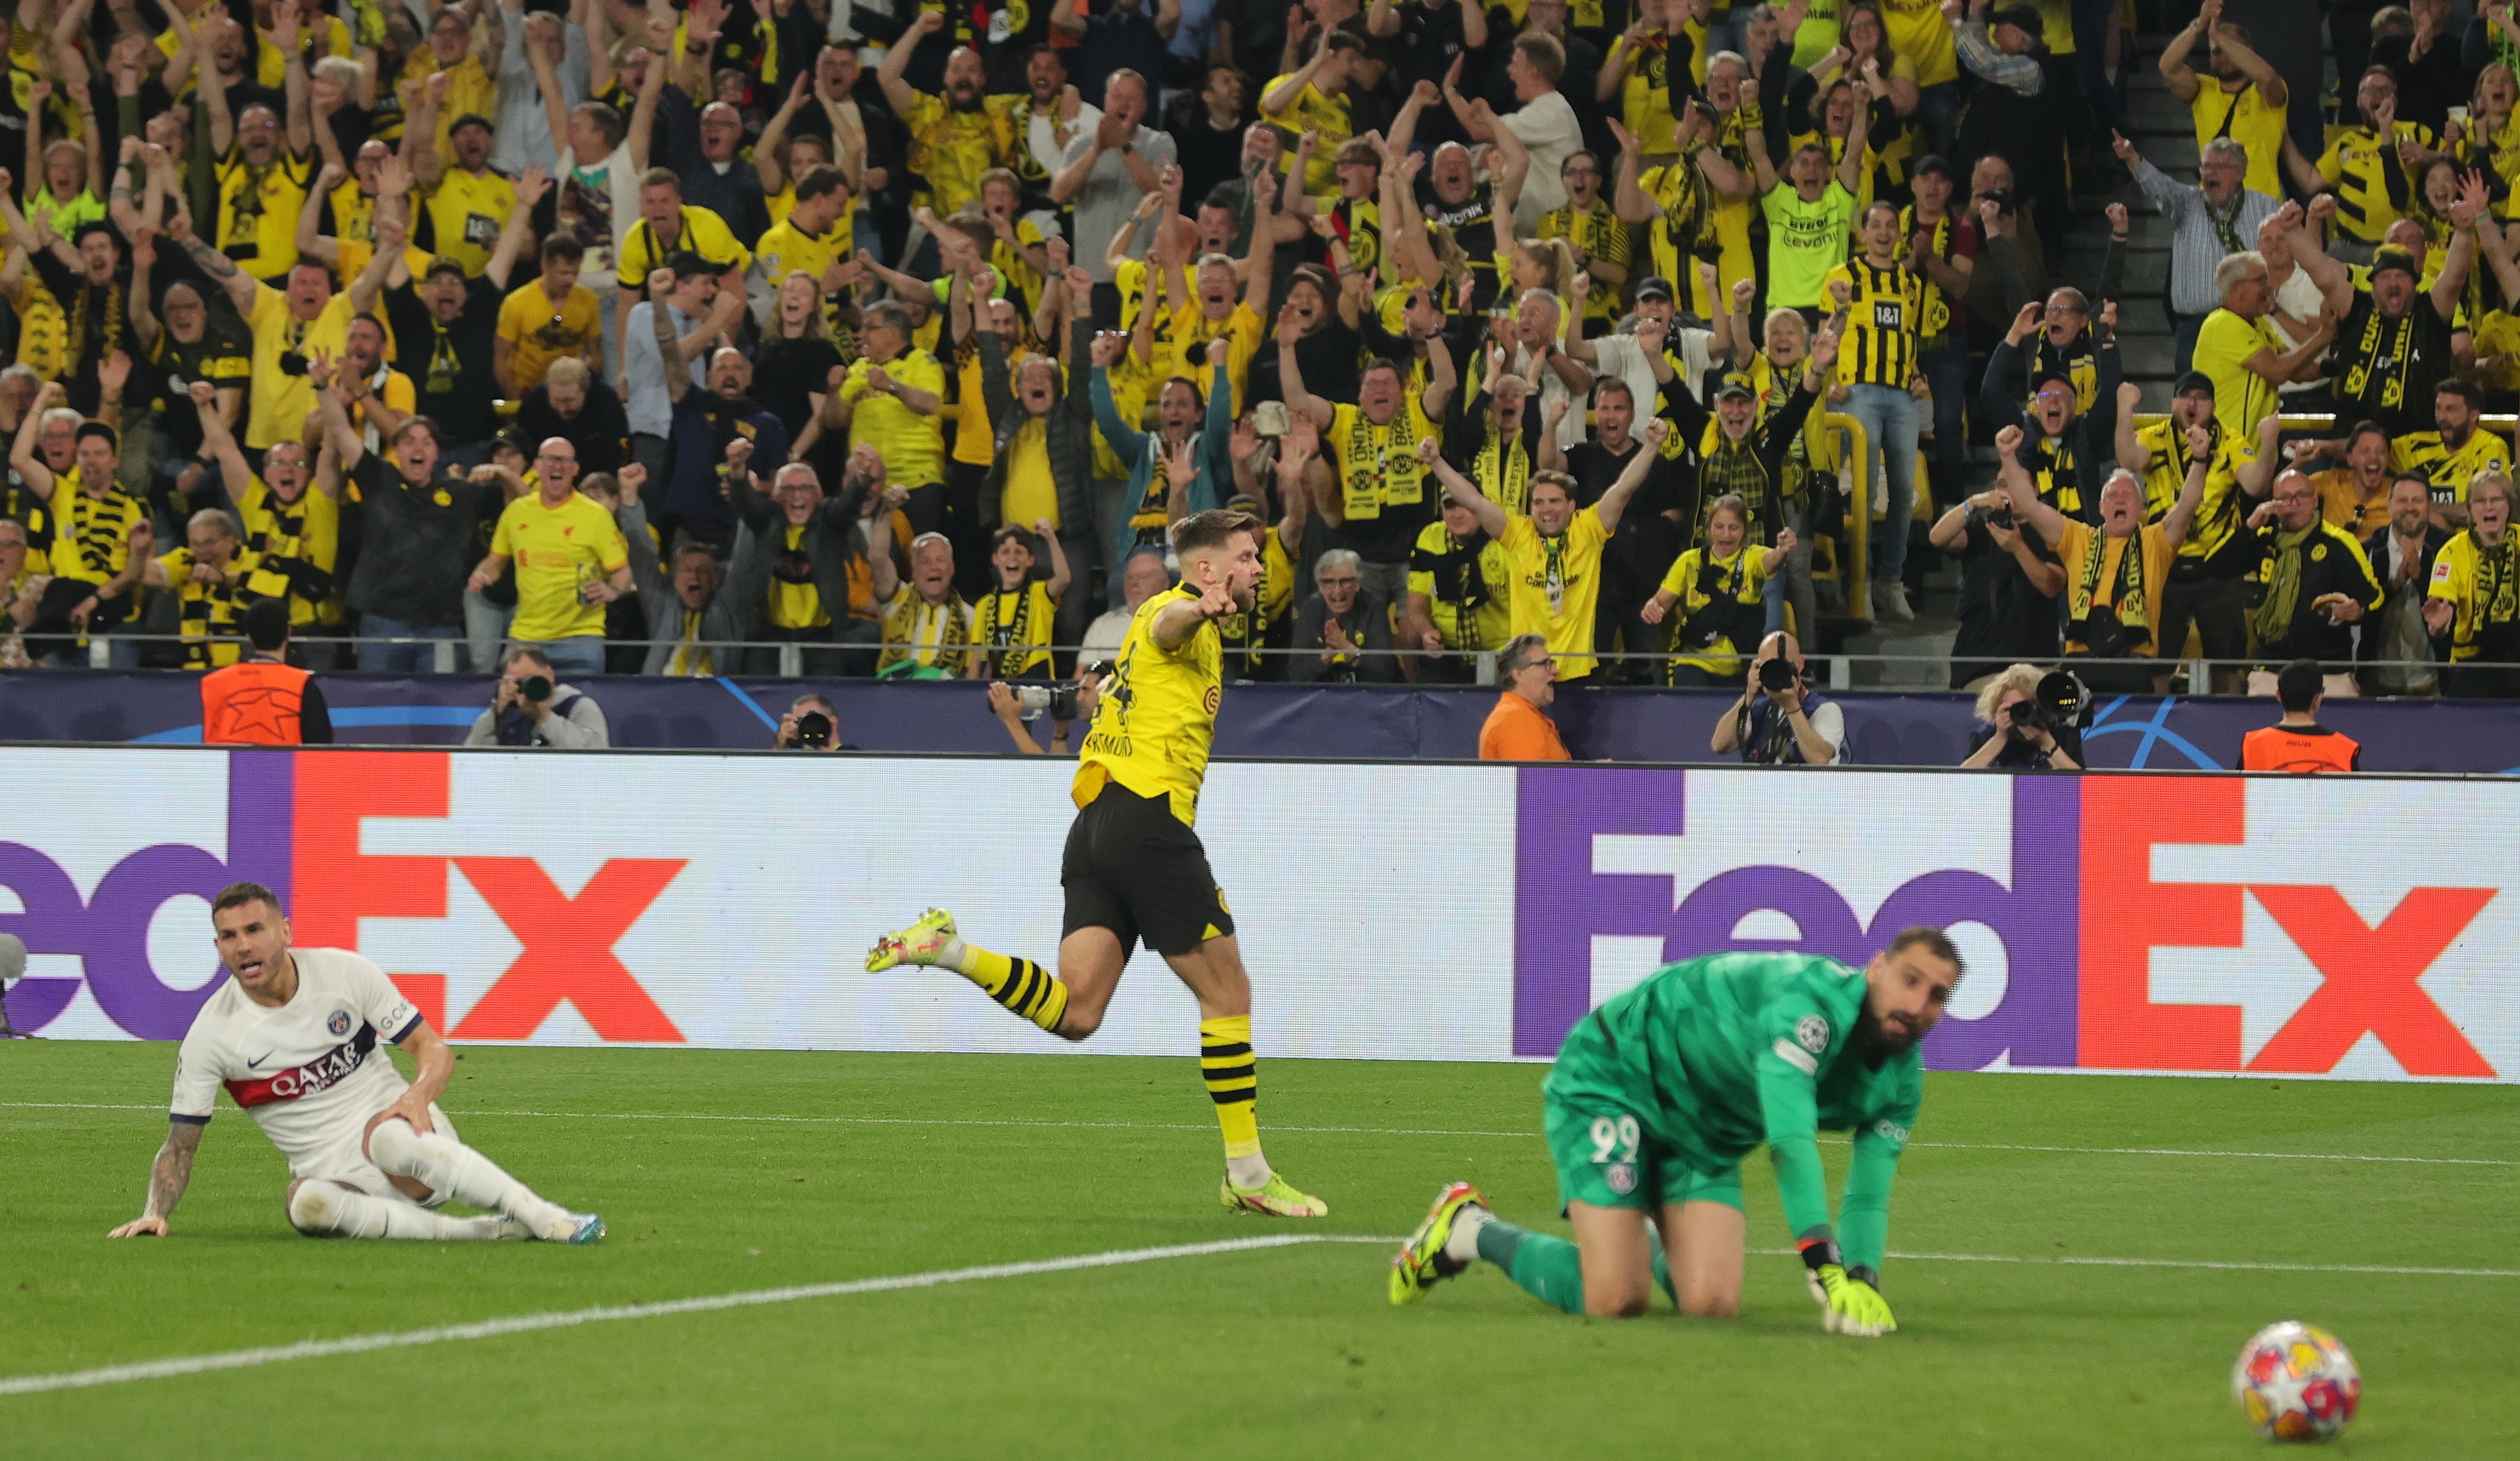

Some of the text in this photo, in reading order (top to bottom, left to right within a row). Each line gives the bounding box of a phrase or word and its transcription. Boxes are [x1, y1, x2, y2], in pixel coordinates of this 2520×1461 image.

[1439, 202, 1483, 227] vonik
[1875, 307, 1899, 324] 1&1
[0, 750, 689, 1043] edEx
[380, 999, 409, 1030] GOA
[271, 1041, 357, 1096] QATAR
[1590, 1115, 1640, 1163] 99
